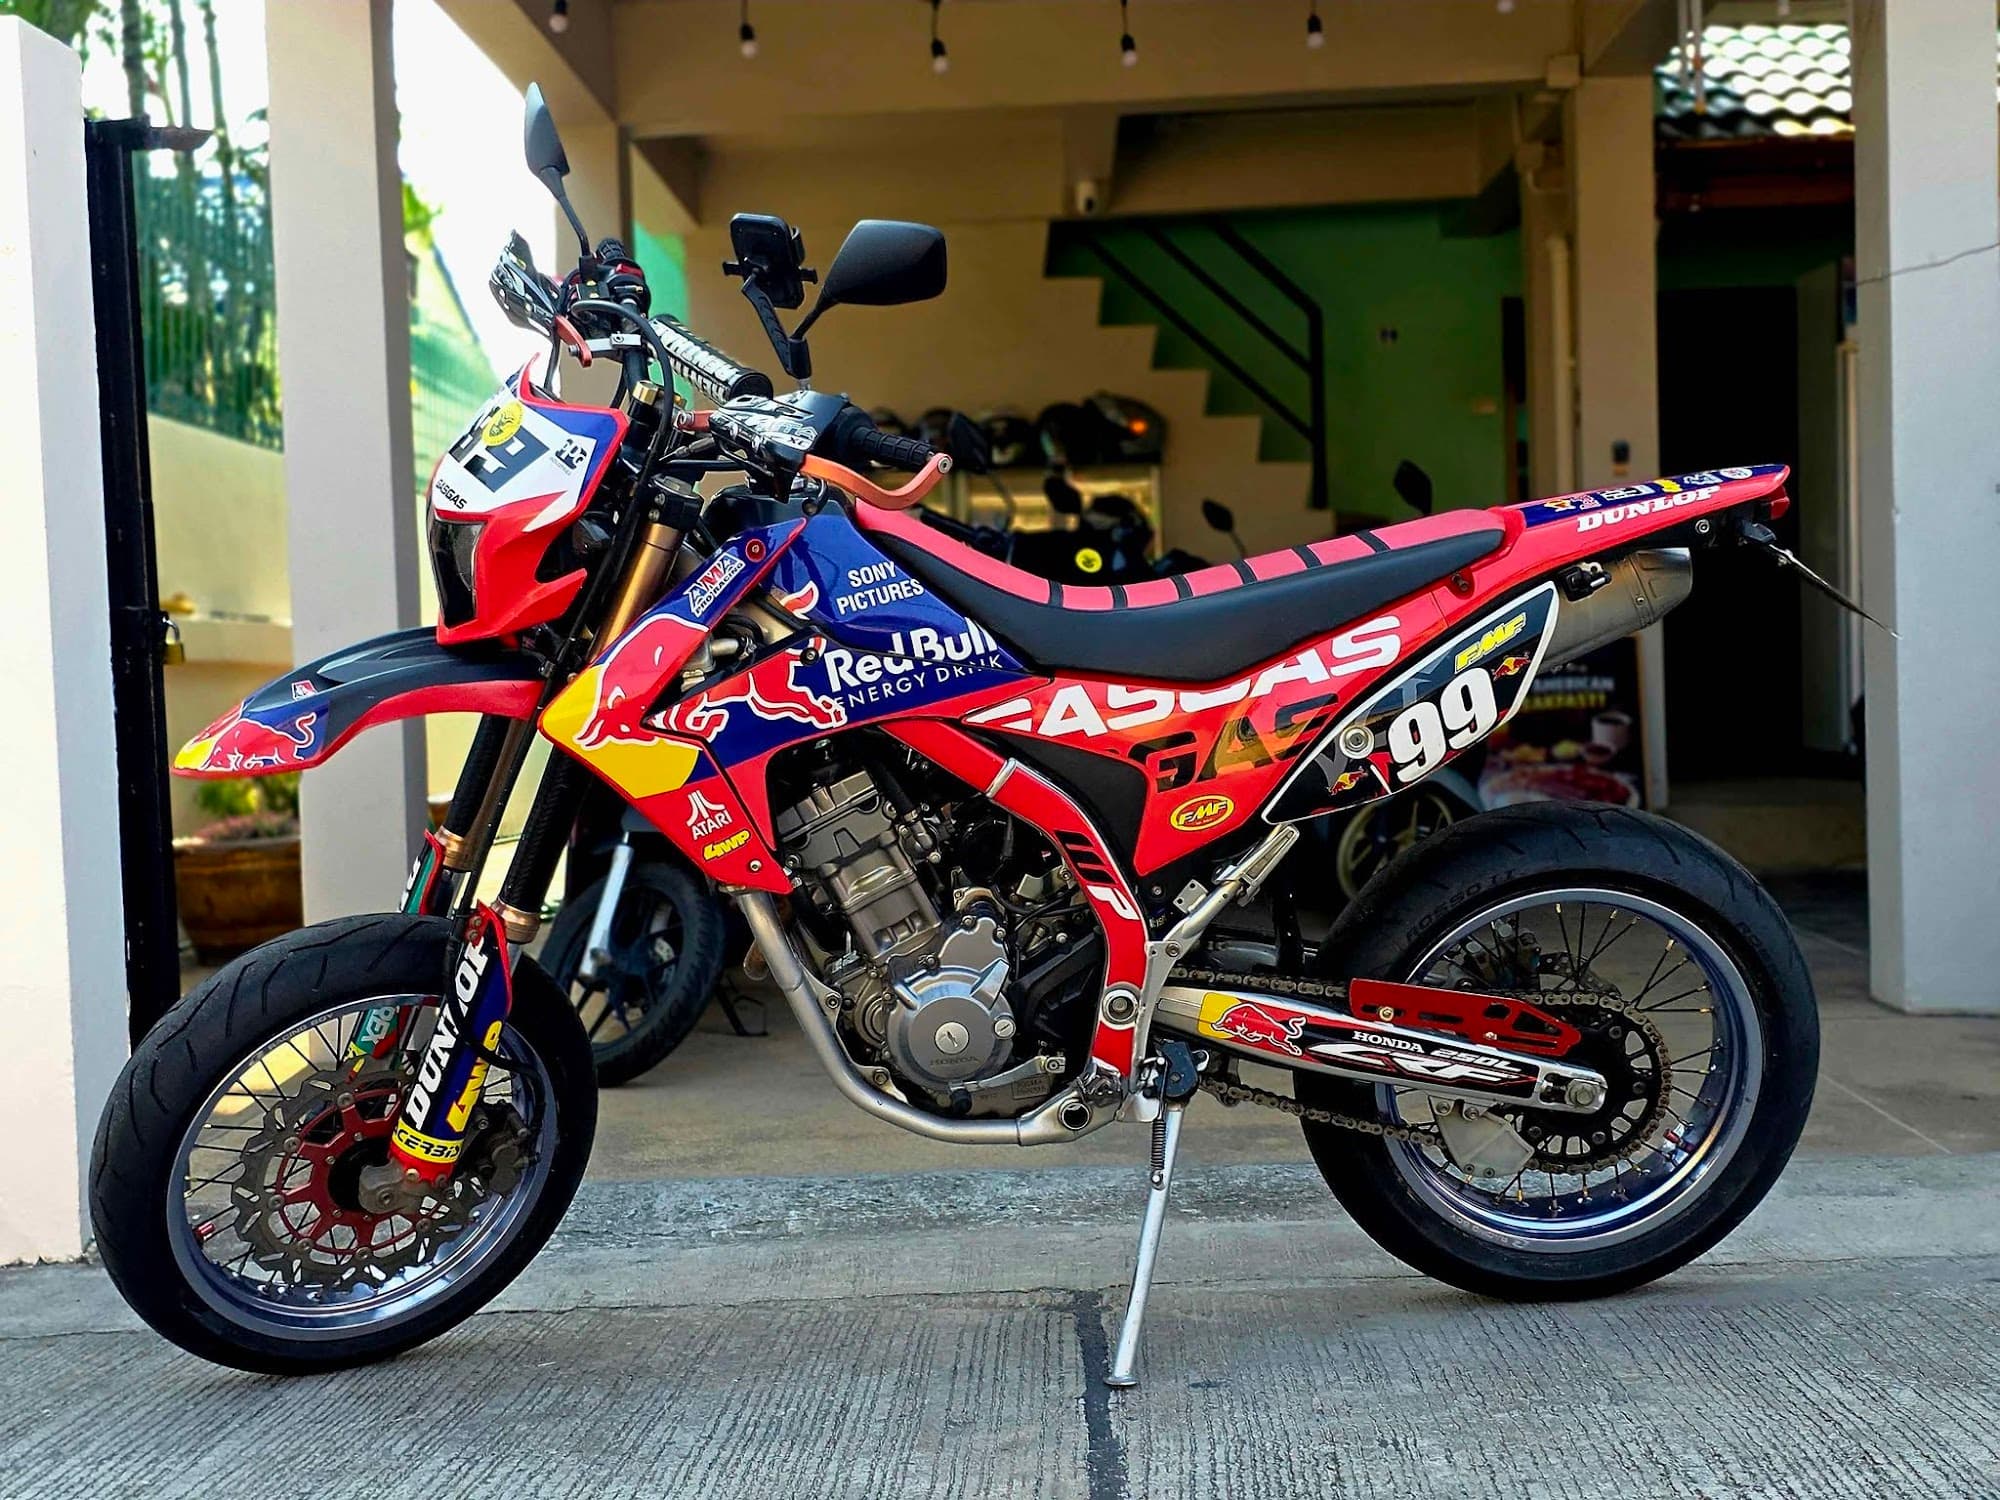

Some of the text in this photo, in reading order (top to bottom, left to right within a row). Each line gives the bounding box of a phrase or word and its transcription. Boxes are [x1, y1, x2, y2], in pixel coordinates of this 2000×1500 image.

[1577, 485, 1721, 532] DUNLOP
[687, 554, 738, 604] AMA
[695, 562, 743, 615] PRO RACING
[836, 578, 925, 615] PICTURES
[847, 561, 897, 588] SONY
[824, 616, 998, 692] Red Bull
[1455, 613, 1526, 672] FMF
[1388, 667, 1498, 783] 99
[691, 810, 733, 840] ATARI
[1179, 801, 1227, 825] FMF
[1309, 1043, 1520, 1082] CRF
[1352, 1031, 1522, 1072] HONDA 250L
